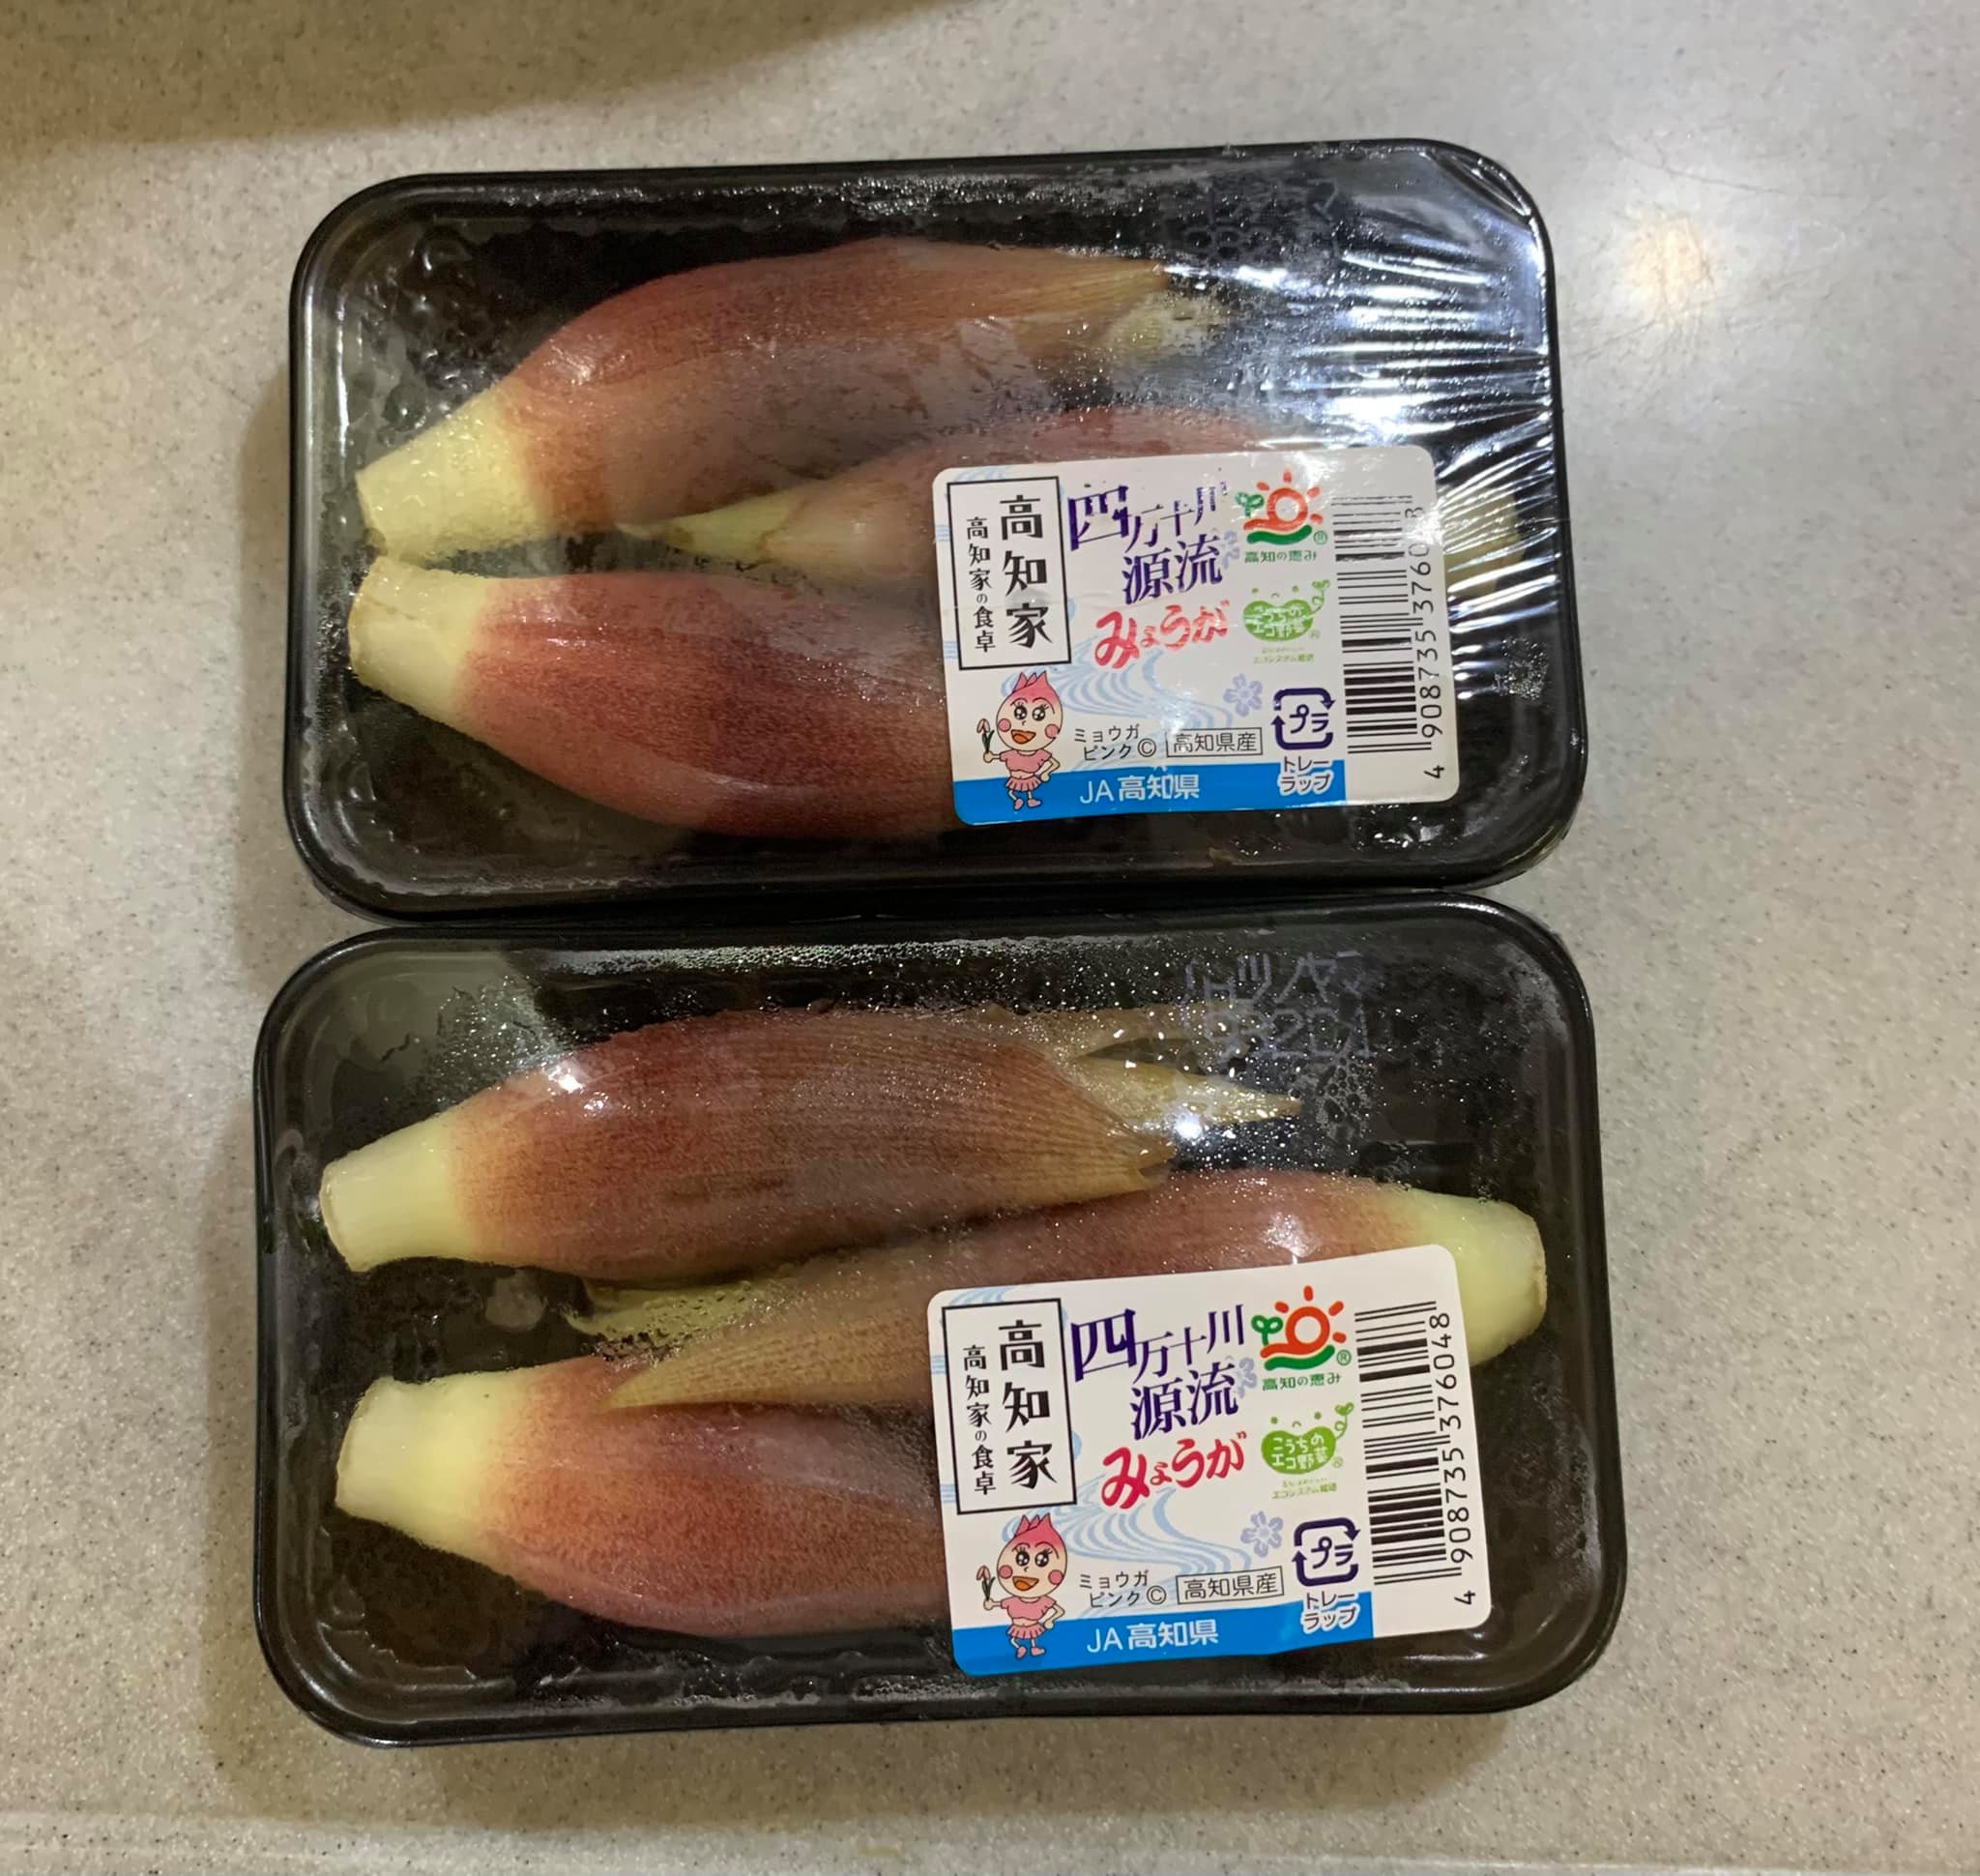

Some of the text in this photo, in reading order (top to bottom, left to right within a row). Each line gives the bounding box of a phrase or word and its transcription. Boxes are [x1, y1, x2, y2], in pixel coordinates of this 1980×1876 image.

[1122, 534, 1222, 604] 源流
[1244, 548, 1318, 564] 高知の恵み
[966, 515, 996, 654] 高知家の食卓
[1000, 494, 1054, 649] 高知家
[1095, 599, 1231, 669] みょうが
[1074, 722, 1141, 744] ミョウガ
[1289, 708, 1331, 734] プラ
[1173, 731, 1258, 753] 高知県産
[1283, 755, 1330, 773] トレー
[1280, 773, 1332, 794] ラップ
[1070, 1304, 1244, 1385] 四万十川
[1262, 1371, 1342, 1392] 高知の恵み
[998, 1319, 1058, 1489] 高知家
[1129, 1362, 1239, 1441] 源流
[963, 1344, 997, 1495] 高知家の食卓
[1272, 1431, 1325, 1454] こうちの
[1101, 1430, 1247, 1510] みょうが
[1271, 1447, 1328, 1471] エコ野菜
[1310, 1536, 1354, 1568] プラ
[1079, 1568, 1150, 1590] ミョウガ
[1183, 1572, 1278, 1601] 高知県産
[1306, 1590, 1355, 1610] トレー
[1303, 1605, 1358, 1632] ラップ
